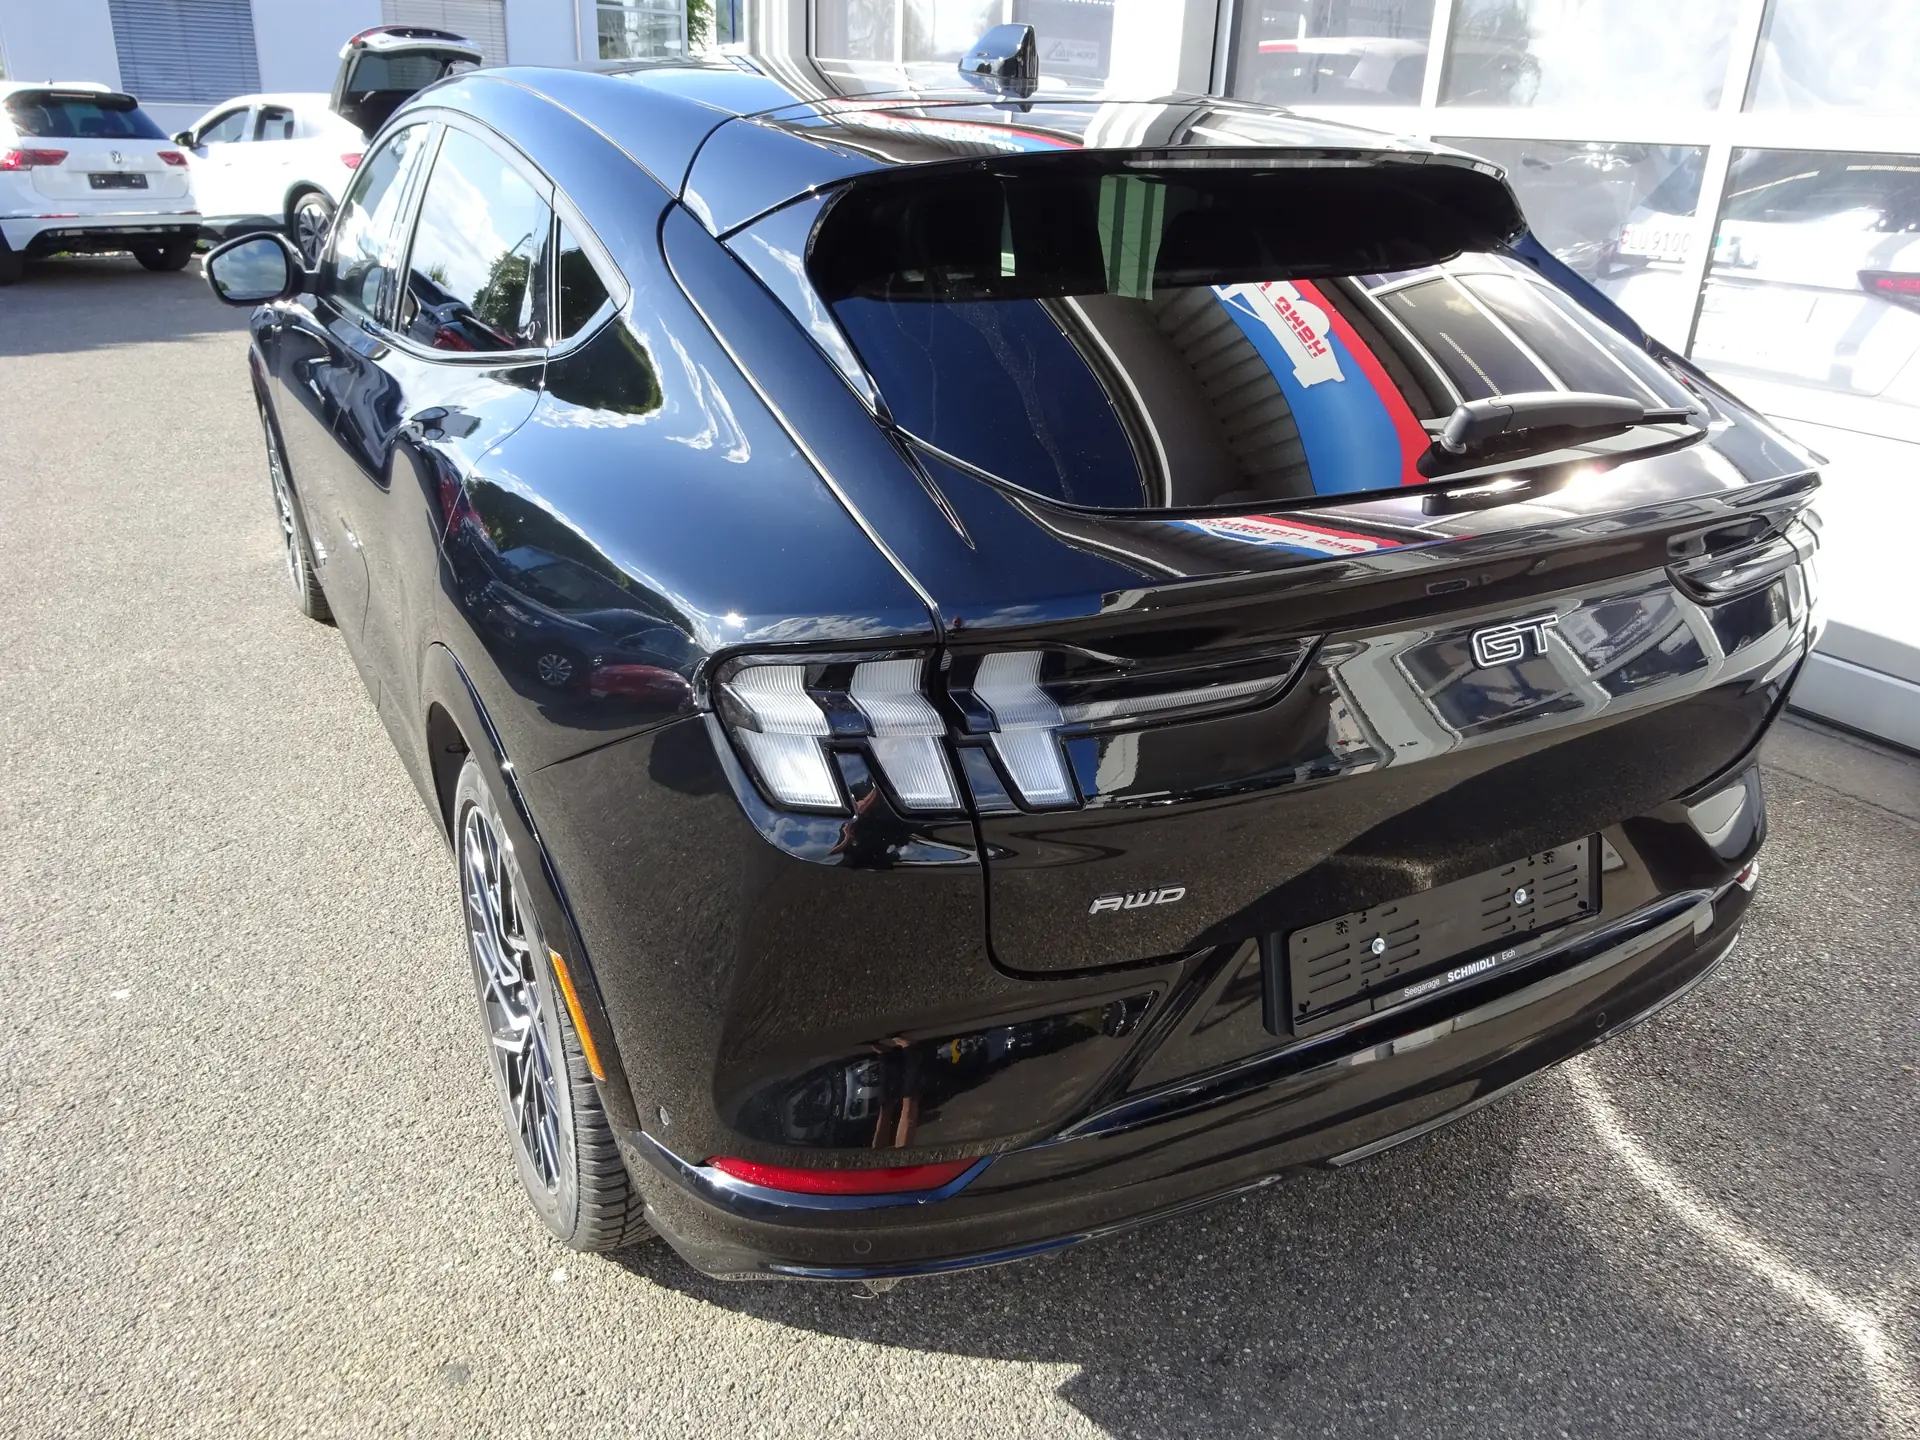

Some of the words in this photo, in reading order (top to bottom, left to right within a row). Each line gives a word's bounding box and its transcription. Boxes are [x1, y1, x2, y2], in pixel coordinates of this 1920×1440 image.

[1472, 613, 1559, 668] GT
[1088, 887, 1186, 915] AWD
[1404, 978, 1440, 997] Seegarage
[1447, 956, 1496, 983] SCHMIDLI
[1501, 949, 1516, 961] Eich
